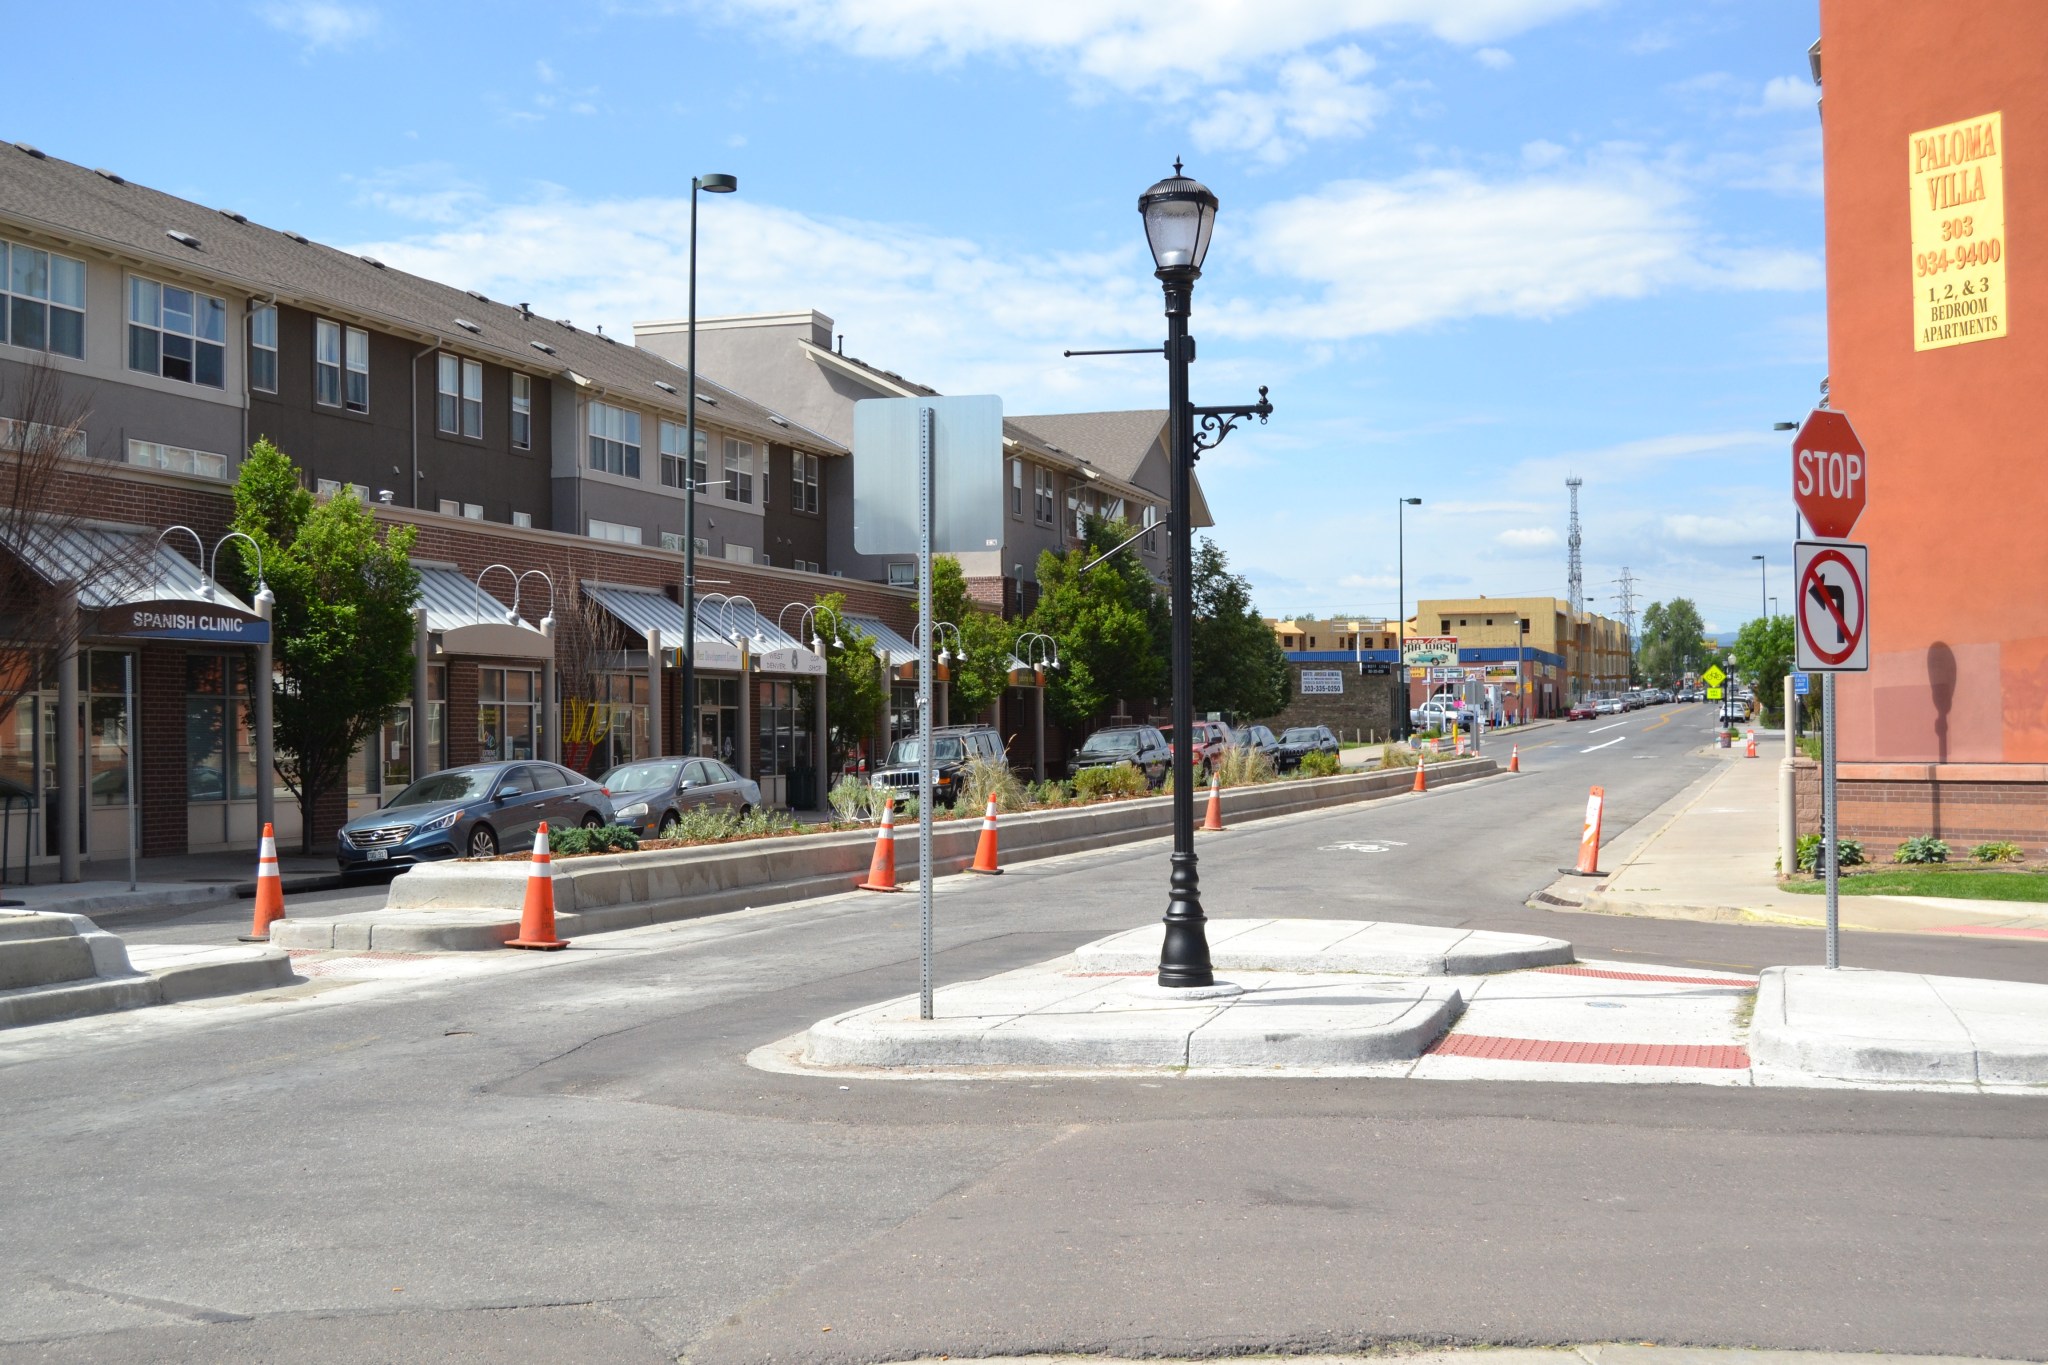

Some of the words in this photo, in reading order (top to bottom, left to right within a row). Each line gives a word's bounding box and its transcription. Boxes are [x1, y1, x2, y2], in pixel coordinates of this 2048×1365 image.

[1914, 122, 1996, 174] PALOMA
[1926, 166, 1986, 211] VILLA
[1941, 215, 1974, 242] 303
[1916, 238, 2001, 277] 934-9400
[1929, 287, 1941, 304] 1,
[1944, 284, 1958, 300] 2,
[1962, 279, 1975, 296] &
[1979, 277, 1990, 293] 3
[1931, 297, 1988, 322] BEDROOM
[1923, 316, 1998, 343] APARTMENTS
[1797, 449, 1862, 500] STOP
[133, 611, 196, 630] SPANISH
[199, 615, 243, 633] CLINIC
[1425, 643, 1457, 655] WASH
[766, 662, 787, 670] DENVER
[808, 664, 822, 672] SHOP
